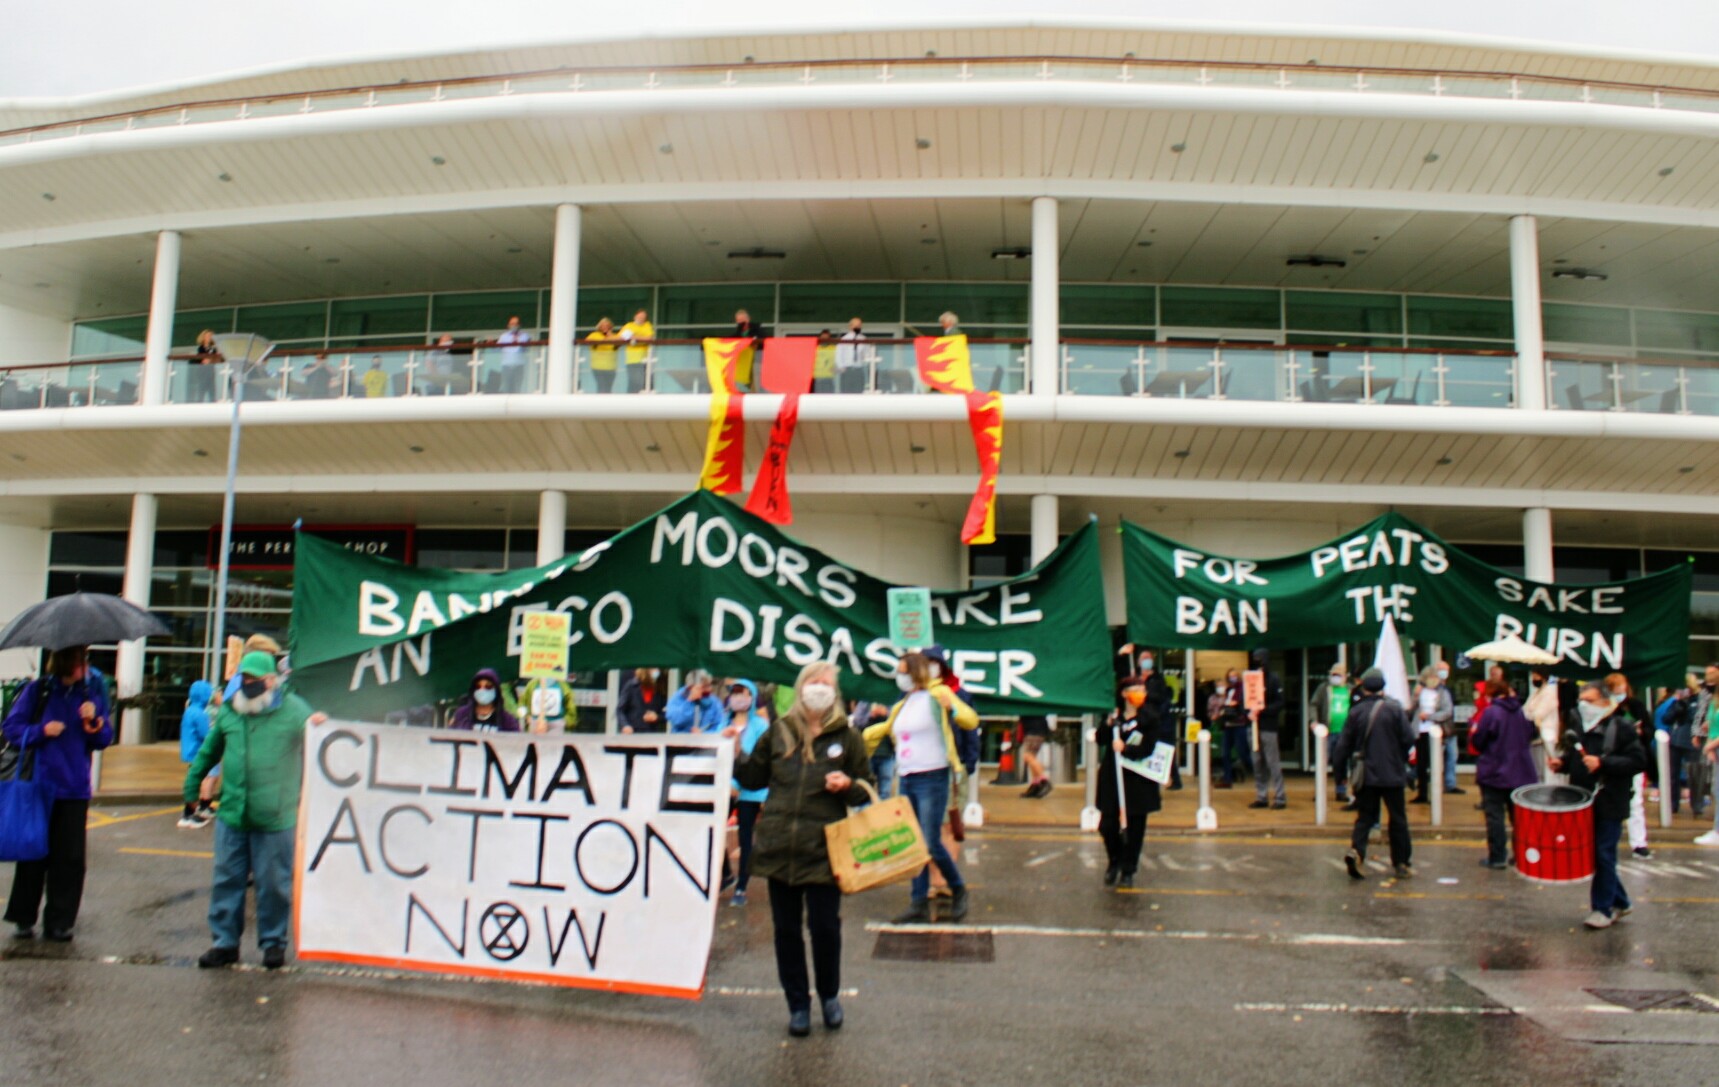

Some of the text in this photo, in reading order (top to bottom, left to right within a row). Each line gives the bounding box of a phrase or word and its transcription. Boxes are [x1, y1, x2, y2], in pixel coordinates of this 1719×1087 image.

[649, 510, 858, 608] MOORS
[1174, 548, 1269, 586] FOR
[1494, 577, 1626, 614] SAKE
[507, 590, 633, 657] ECO
[710, 597, 1044, 698] DISASER
[1175, 596, 1268, 636] BAN
[1345, 584, 1417, 625] THE
[316, 729, 719, 813] CLIMATE
[308, 797, 714, 902] ACTION
